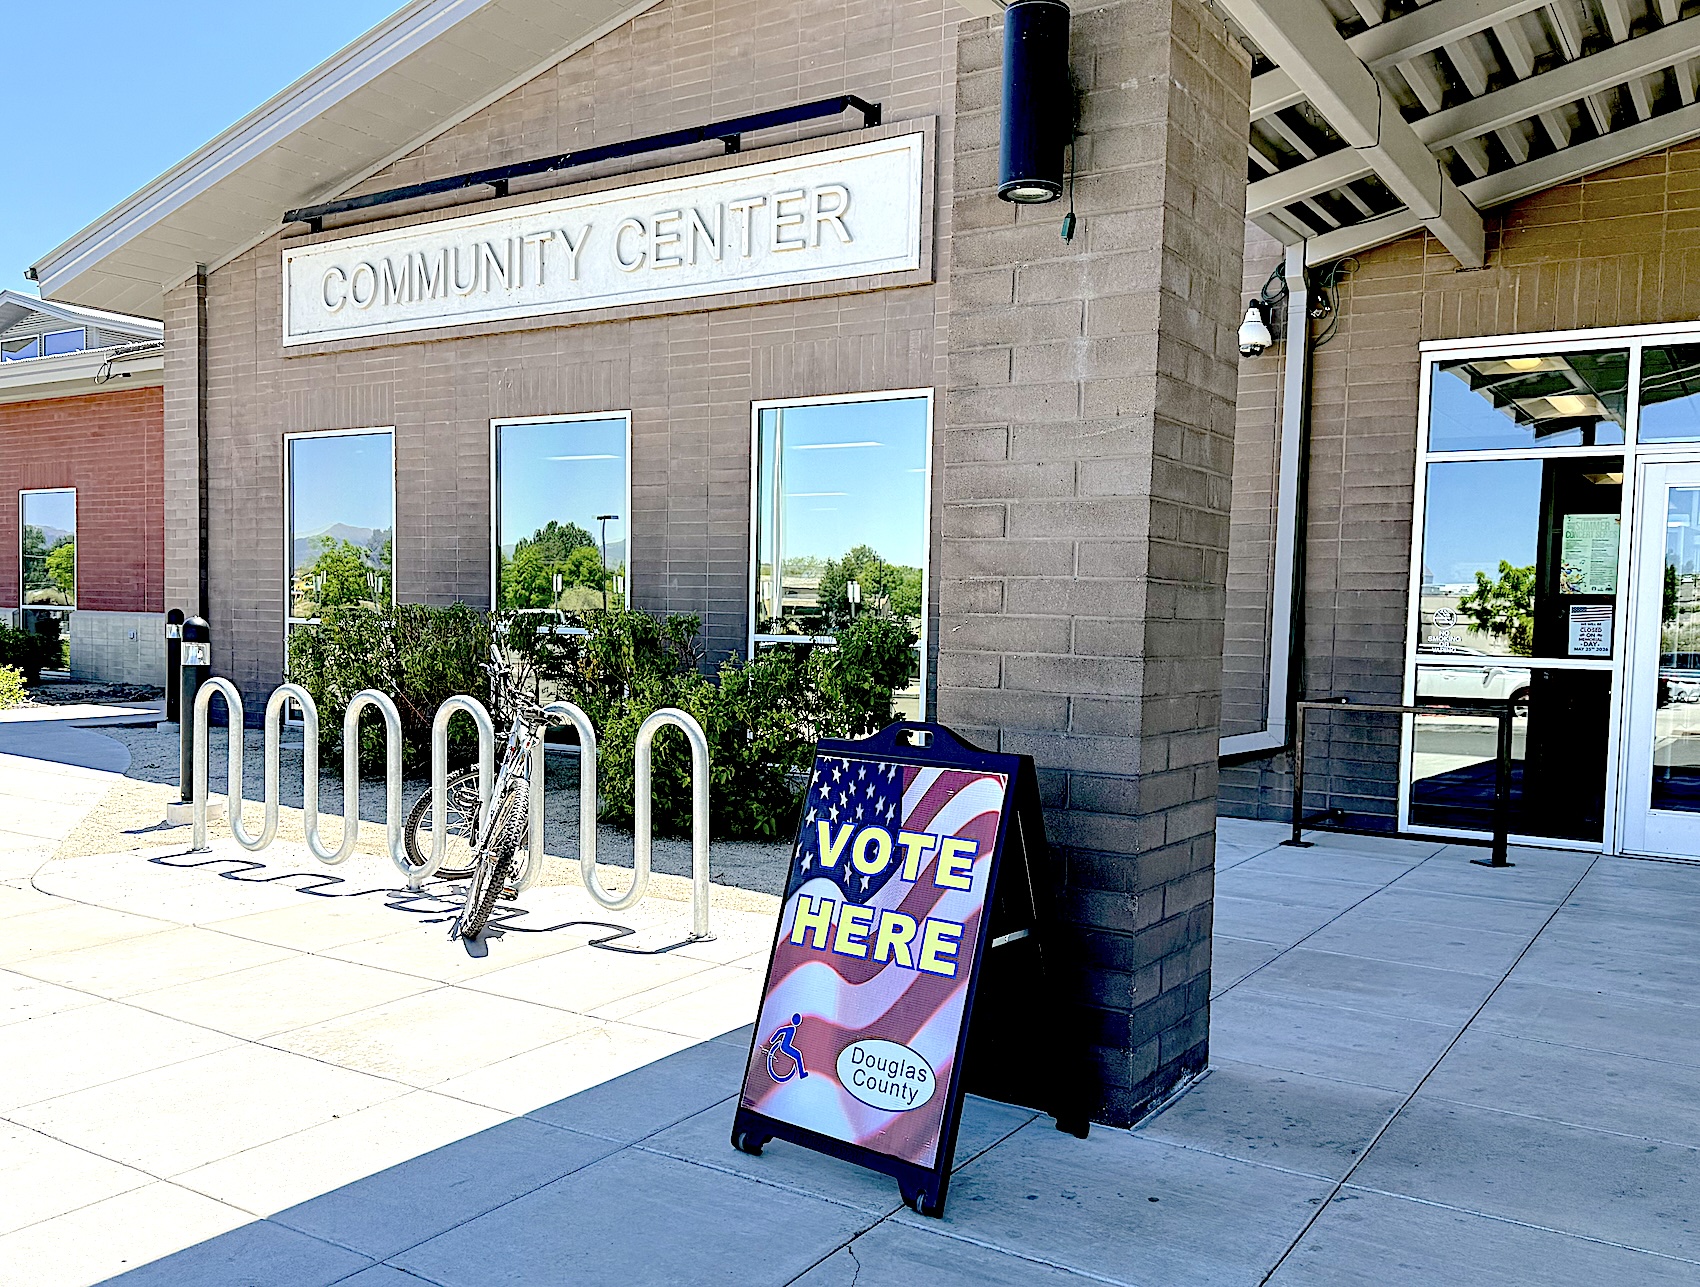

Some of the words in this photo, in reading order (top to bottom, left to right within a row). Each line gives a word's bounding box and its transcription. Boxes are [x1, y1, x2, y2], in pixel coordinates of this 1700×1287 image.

[320, 224, 592, 313] COMMUNITY
[615, 182, 854, 273] CENTER
[1565, 531, 1593, 539] CONCERT
[1576, 521, 1610, 531] SUMMER
[815, 818, 980, 893] VOTE
[790, 893, 966, 979] HERE
[851, 1046, 928, 1083] Douglas
[852, 1068, 920, 1106] County
